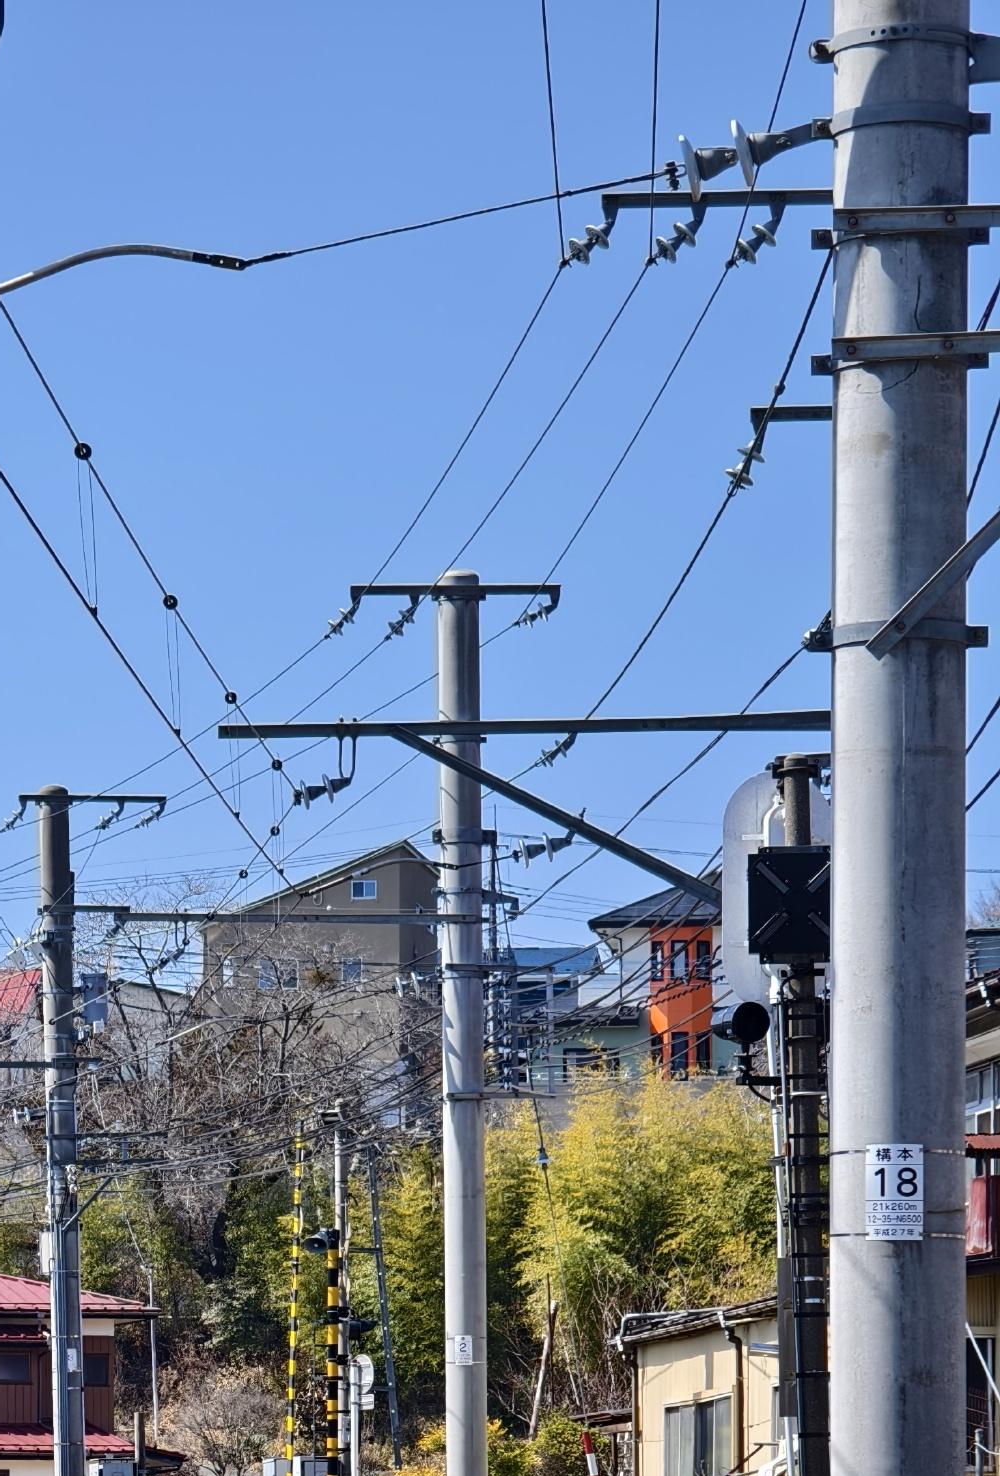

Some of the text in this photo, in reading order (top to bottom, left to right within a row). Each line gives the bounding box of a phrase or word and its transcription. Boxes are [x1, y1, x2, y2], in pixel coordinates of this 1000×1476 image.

[875, 1147, 914, 1162] 構本
[874, 1167, 918, 1197] 18
[872, 1202, 918, 1211] 21k260m
[873, 1228, 915, 1237] 平成27年
[459, 1342, 467, 1352] 2
